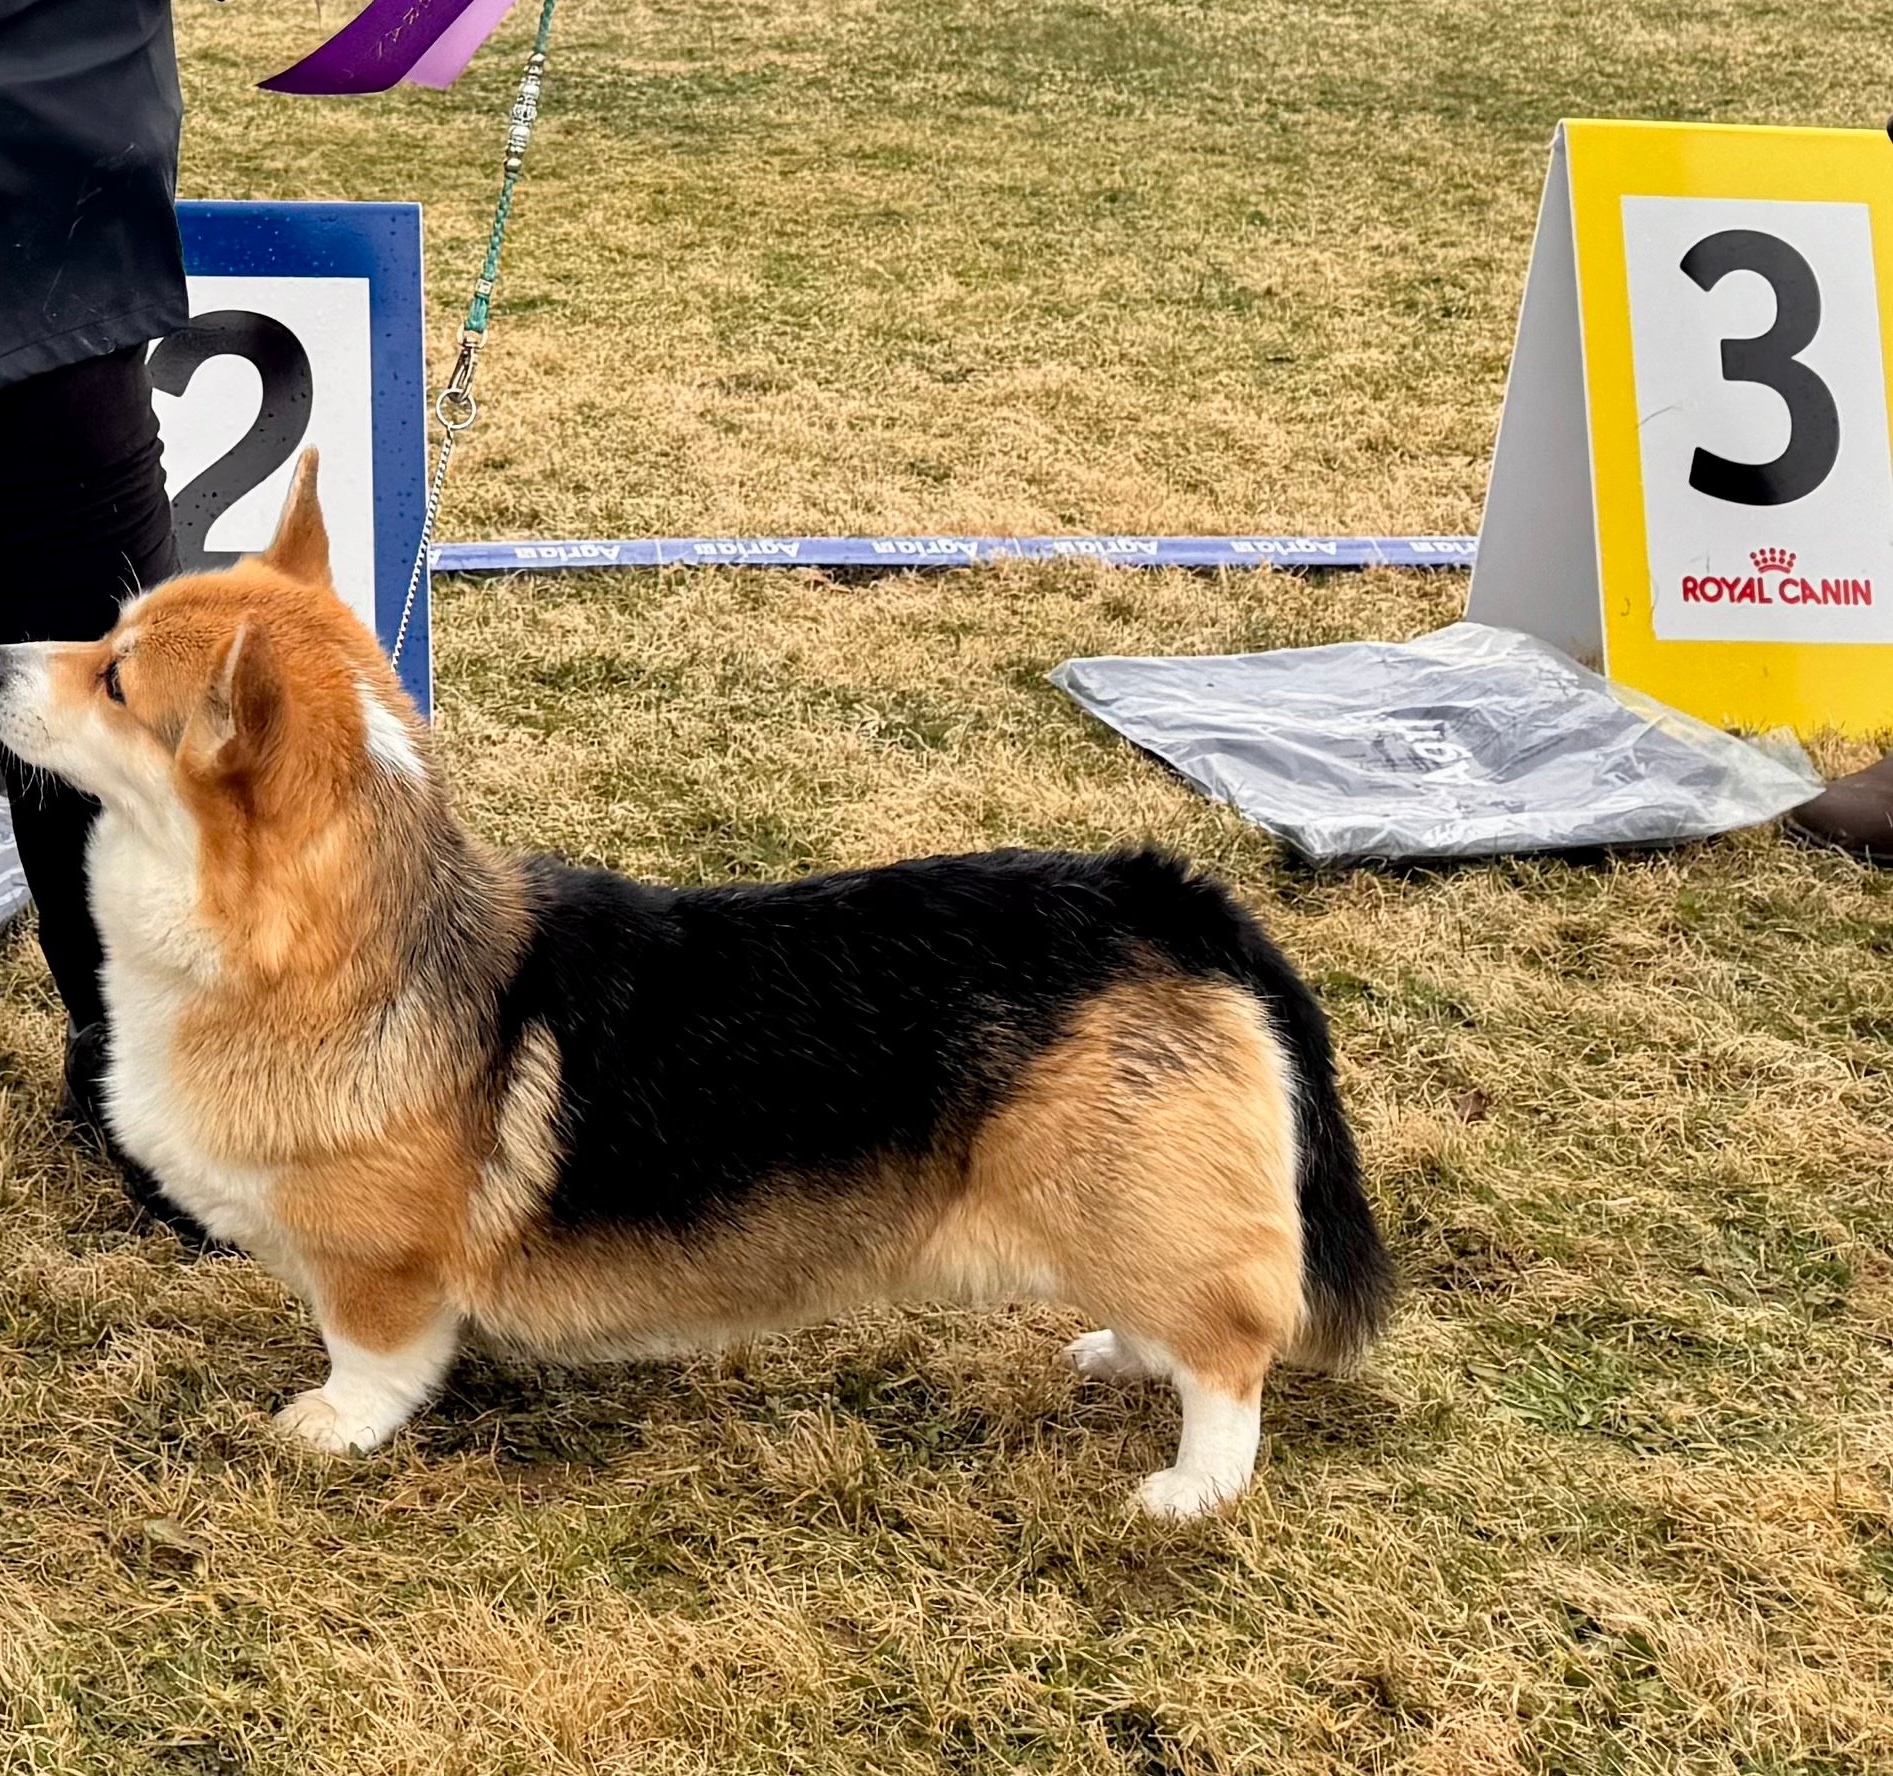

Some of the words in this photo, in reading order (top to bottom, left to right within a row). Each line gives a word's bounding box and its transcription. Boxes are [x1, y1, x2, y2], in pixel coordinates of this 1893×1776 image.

[145, 310, 313, 570] 2
[1680, 229, 1840, 506] 3
[1682, 575, 1773, 604] ROYAL
[1778, 577, 1873, 606] CANIN
